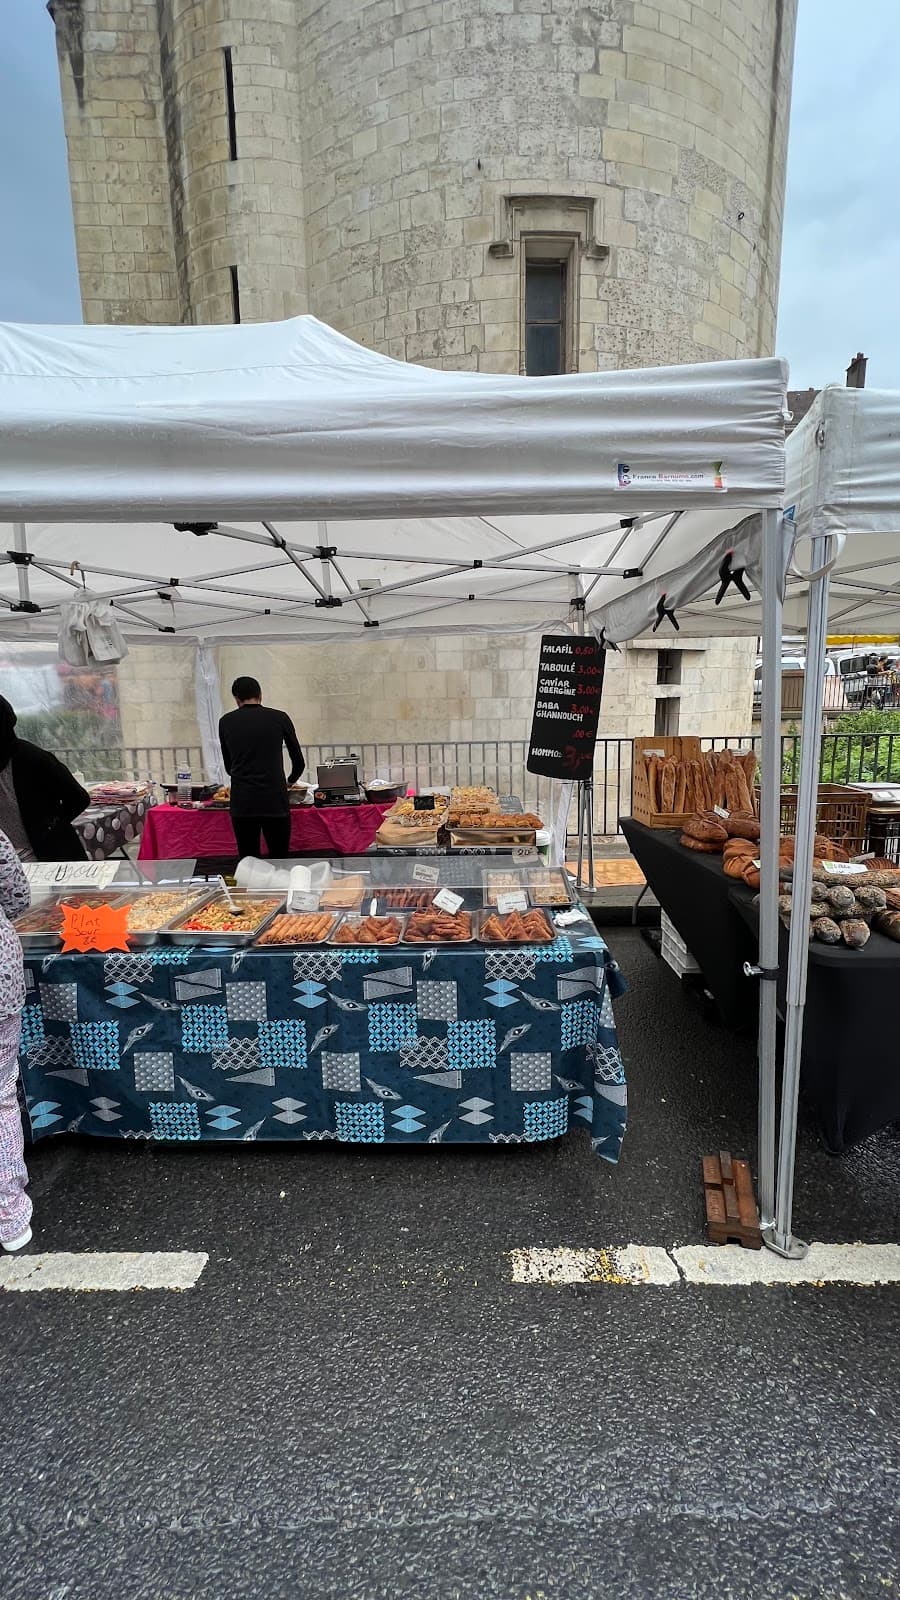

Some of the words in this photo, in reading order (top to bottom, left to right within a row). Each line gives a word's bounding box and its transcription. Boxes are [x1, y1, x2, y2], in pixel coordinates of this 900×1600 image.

[540, 661, 576, 673] TABOULÉ
[536, 701, 560, 710] BABA
[535, 710, 584, 722] GHANNOUCH
